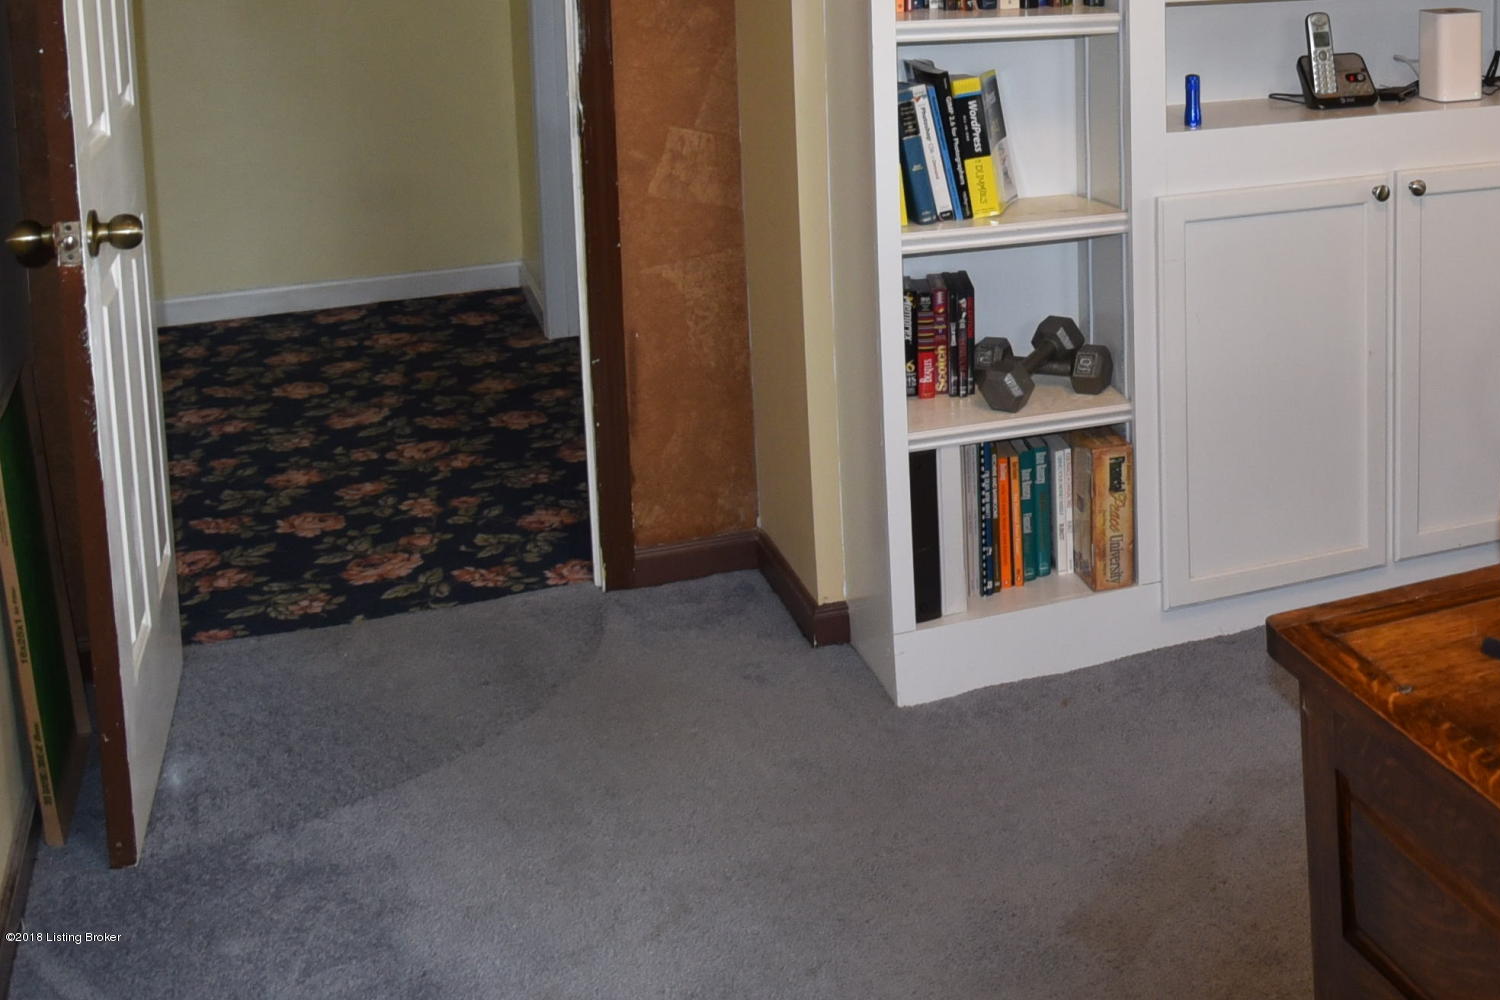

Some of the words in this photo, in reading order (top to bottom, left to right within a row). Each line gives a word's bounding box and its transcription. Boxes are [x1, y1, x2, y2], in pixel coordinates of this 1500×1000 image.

[967, 99, 982, 154] WordPress
[936, 345, 947, 391] Scotch
[1110, 494, 1128, 533] Peace
[1105, 534, 1126, 583] University
